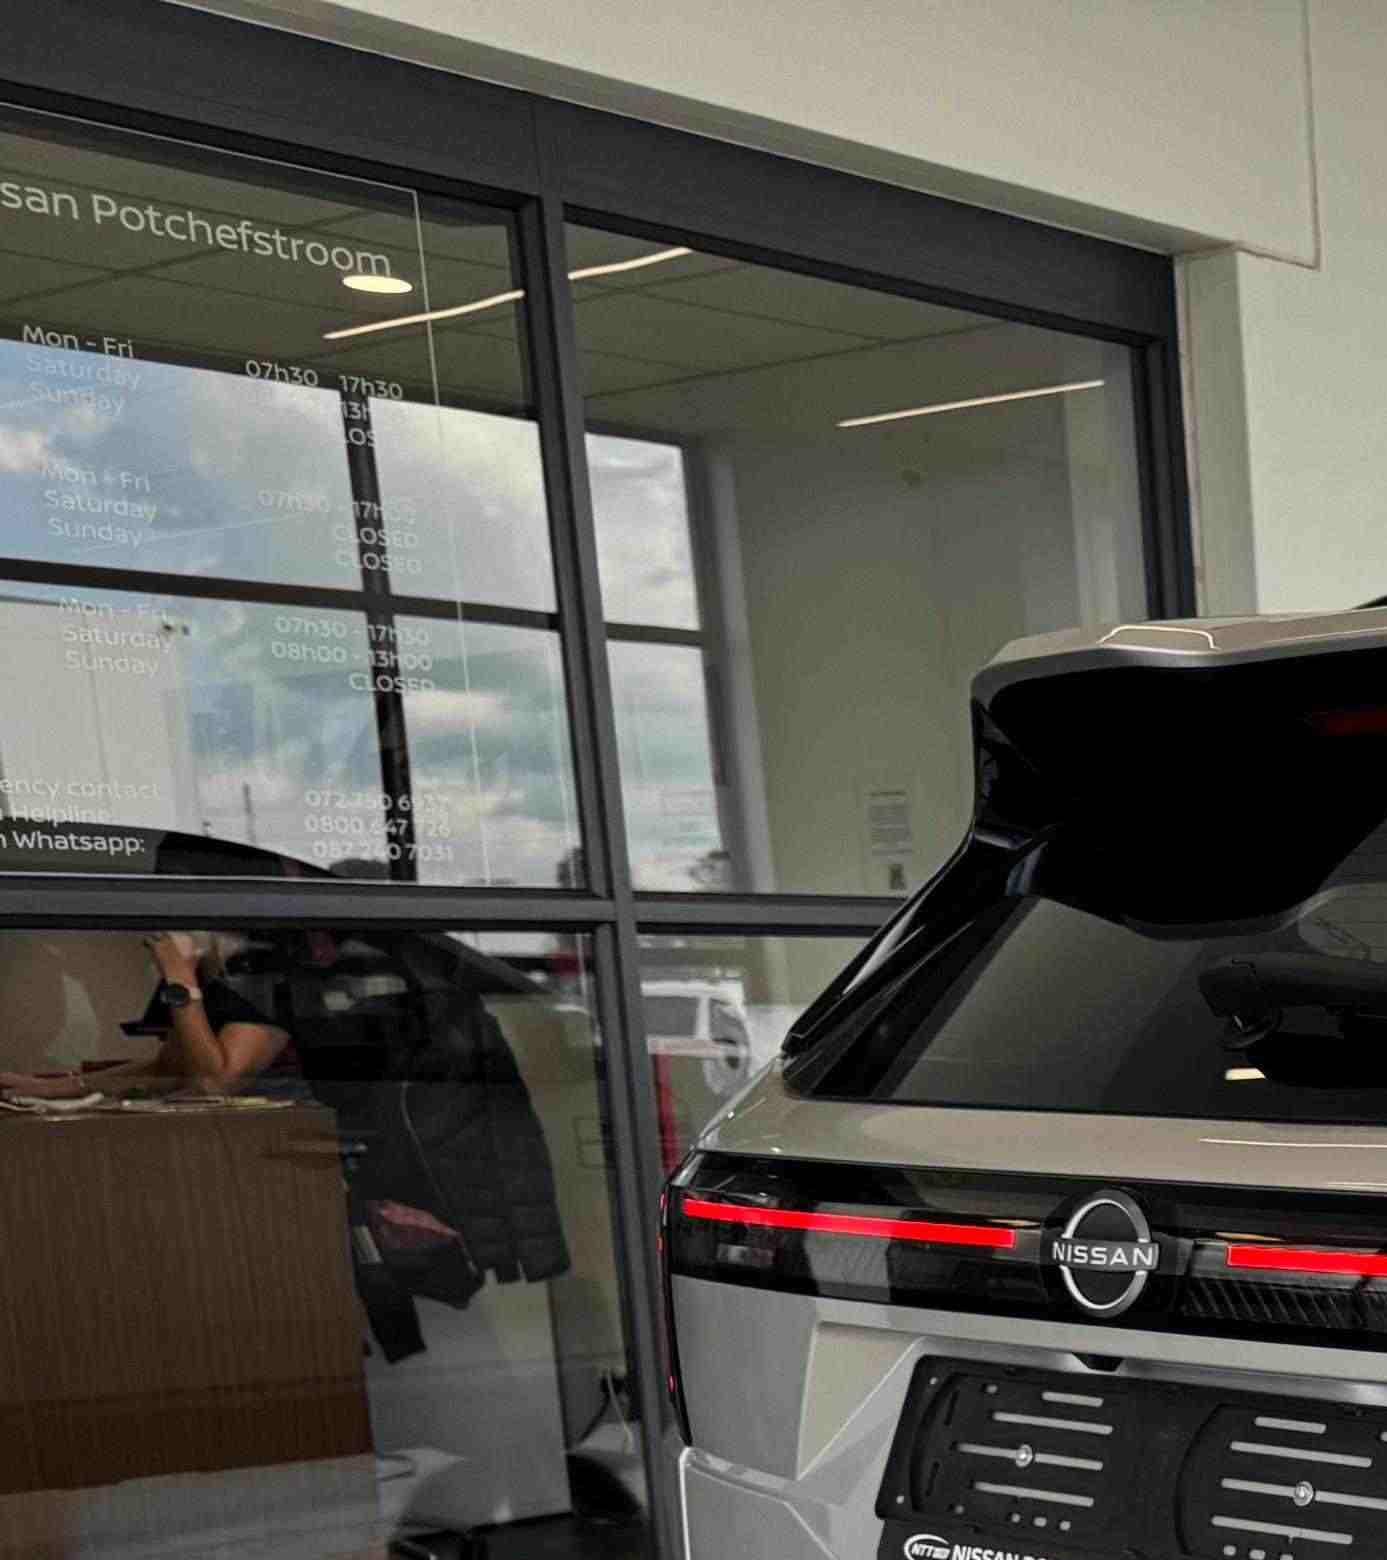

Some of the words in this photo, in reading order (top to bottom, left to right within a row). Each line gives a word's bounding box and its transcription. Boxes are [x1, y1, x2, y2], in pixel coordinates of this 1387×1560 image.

[91, 193, 391, 275] Potchefstroom
[24, 325, 80, 352] Mon
[103, 337, 134, 359] Fri
[246, 360, 319, 386] 07h30
[339, 375, 403, 399] 17h30
[27, 358, 142, 390] Saturday
[31, 383, 125, 417] Sunday
[120, 471, 151, 493] Fri
[44, 489, 160, 524] Saturday
[48, 517, 142, 549] Sunday
[64, 624, 175, 654] Saturday
[271, 641, 346, 663] 08h00
[369, 650, 432, 671] 13h00
[275, 616, 347, 639] 07h30
[368, 624, 430, 647] 17h30
[65, 649, 159, 679] Sunday
[350, 671, 435, 692] CLOSED
[13, 830, 145, 856] Whatsapp:
[1052, 1241, 1153, 1266] NISSAN
